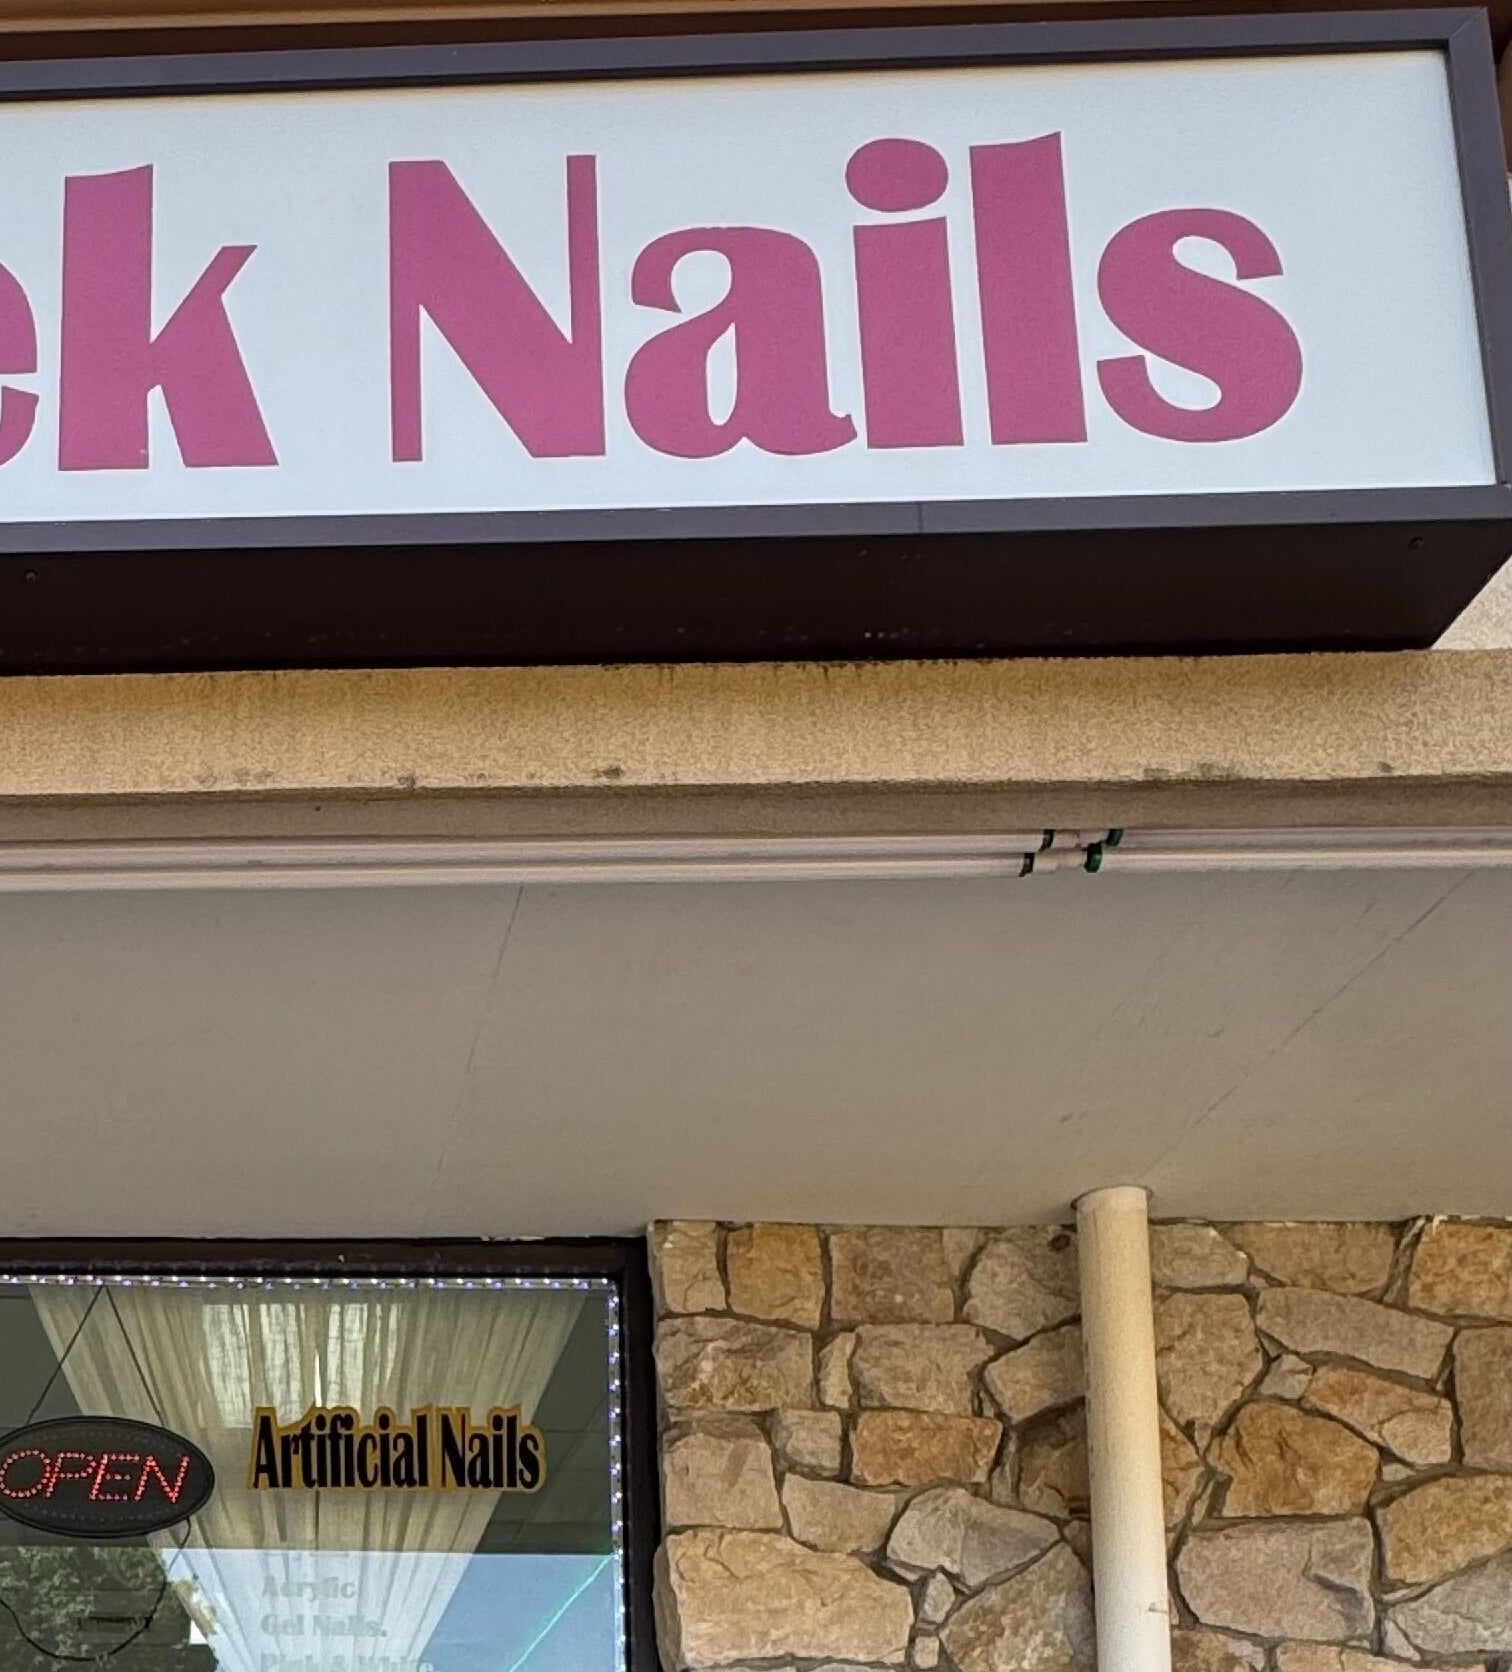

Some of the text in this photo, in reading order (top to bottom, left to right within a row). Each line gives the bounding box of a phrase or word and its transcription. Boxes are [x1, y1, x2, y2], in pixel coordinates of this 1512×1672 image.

[388, 130, 1303, 461] Nails
[252, 1411, 541, 1489] Artificial Nails
